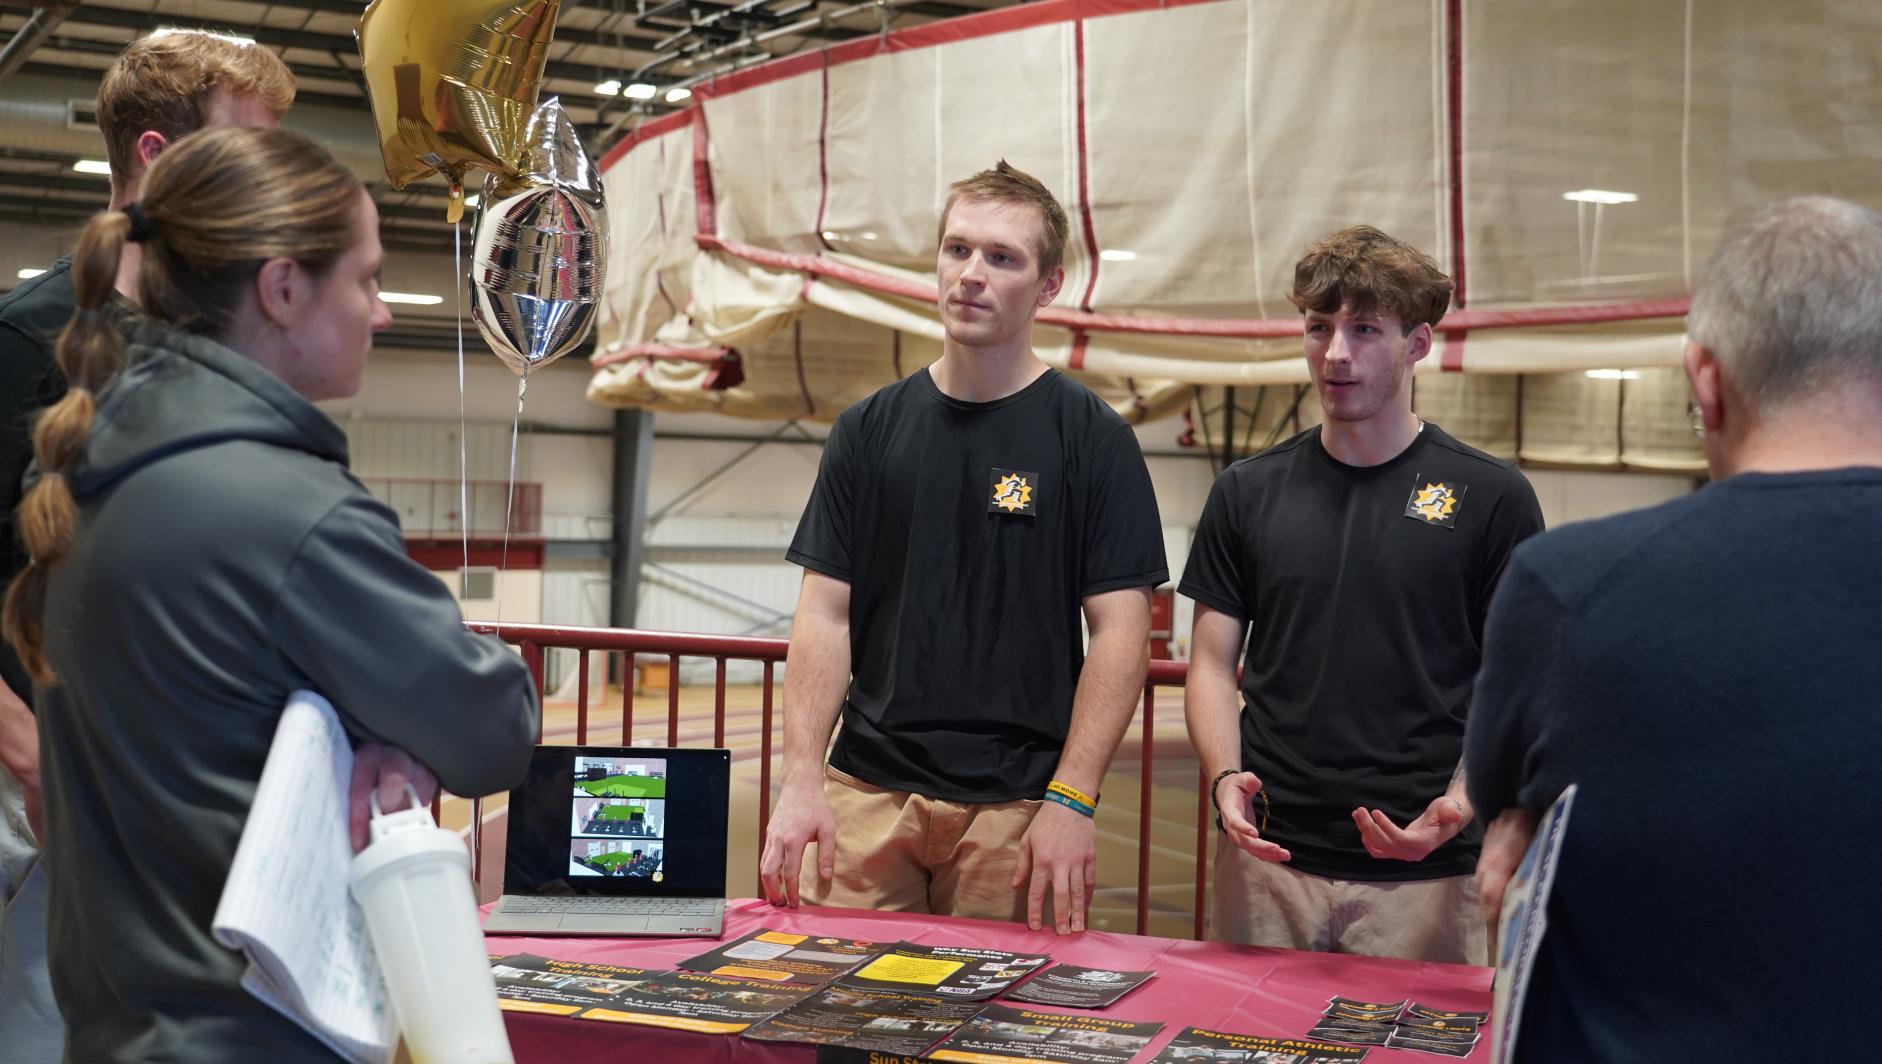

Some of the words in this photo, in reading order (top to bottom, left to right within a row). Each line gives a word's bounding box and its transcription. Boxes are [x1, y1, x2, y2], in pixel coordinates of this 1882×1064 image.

[931, 950, 1003, 959] Performance
[544, 960, 583, 969] High
[588, 964, 646, 974] School
[549, 966, 615, 979] Training
[678, 974, 742, 986] College
[746, 980, 815, 992] Training
[1020, 1011, 1073, 1022] Small
[1076, 1016, 1136, 1029] Group
[1034, 1020, 1110, 1033] Training
[1008, 1040, 1070, 1050] Availability:
[1191, 1029, 1277, 1045] Personal
[1280, 1040, 1361, 1054] Athletic
[1228, 1041, 1308, 1056] Training
[1035, 1046, 1076, 1054] training
[1077, 1052, 1128, 1060] programs
[1042, 1052, 1090, 1060] Saturday
